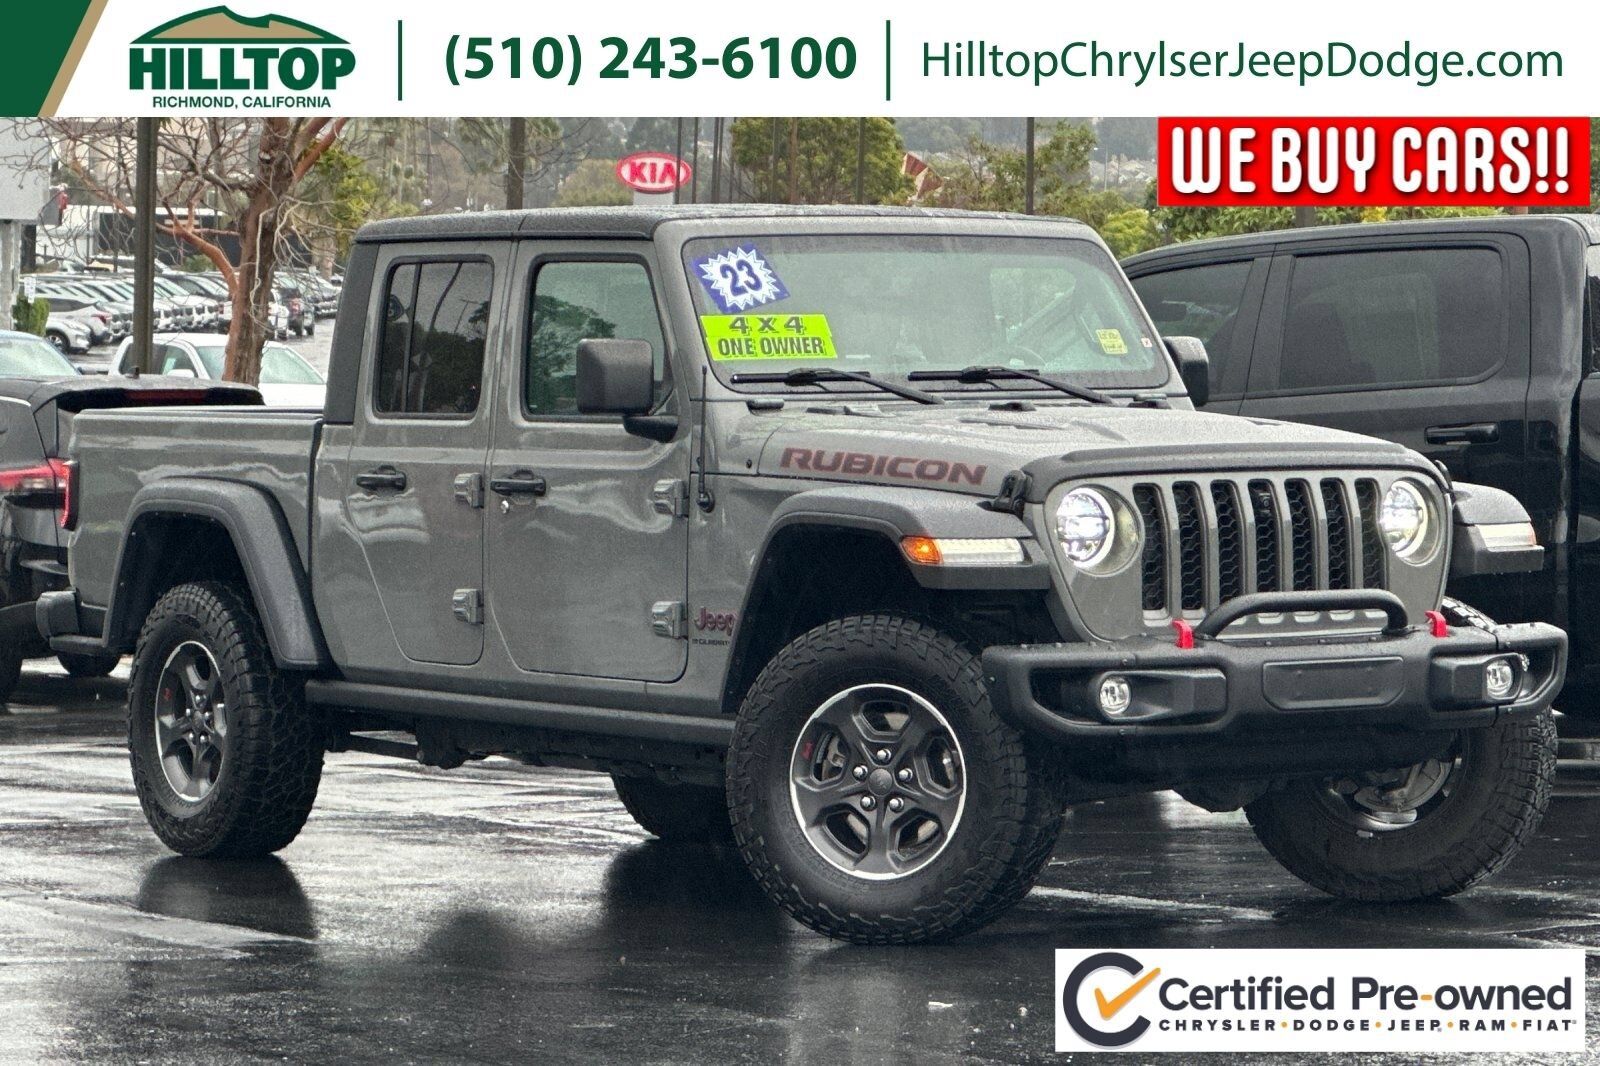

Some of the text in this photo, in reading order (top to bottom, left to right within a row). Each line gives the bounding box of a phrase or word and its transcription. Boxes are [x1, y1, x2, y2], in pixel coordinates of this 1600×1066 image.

[629, 161, 677, 184] KIA
[719, 258, 763, 297] 23
[717, 336, 826, 357] ONE OWNER
[779, 447, 988, 486] RUBICON
[693, 605, 736, 637] Jeep
